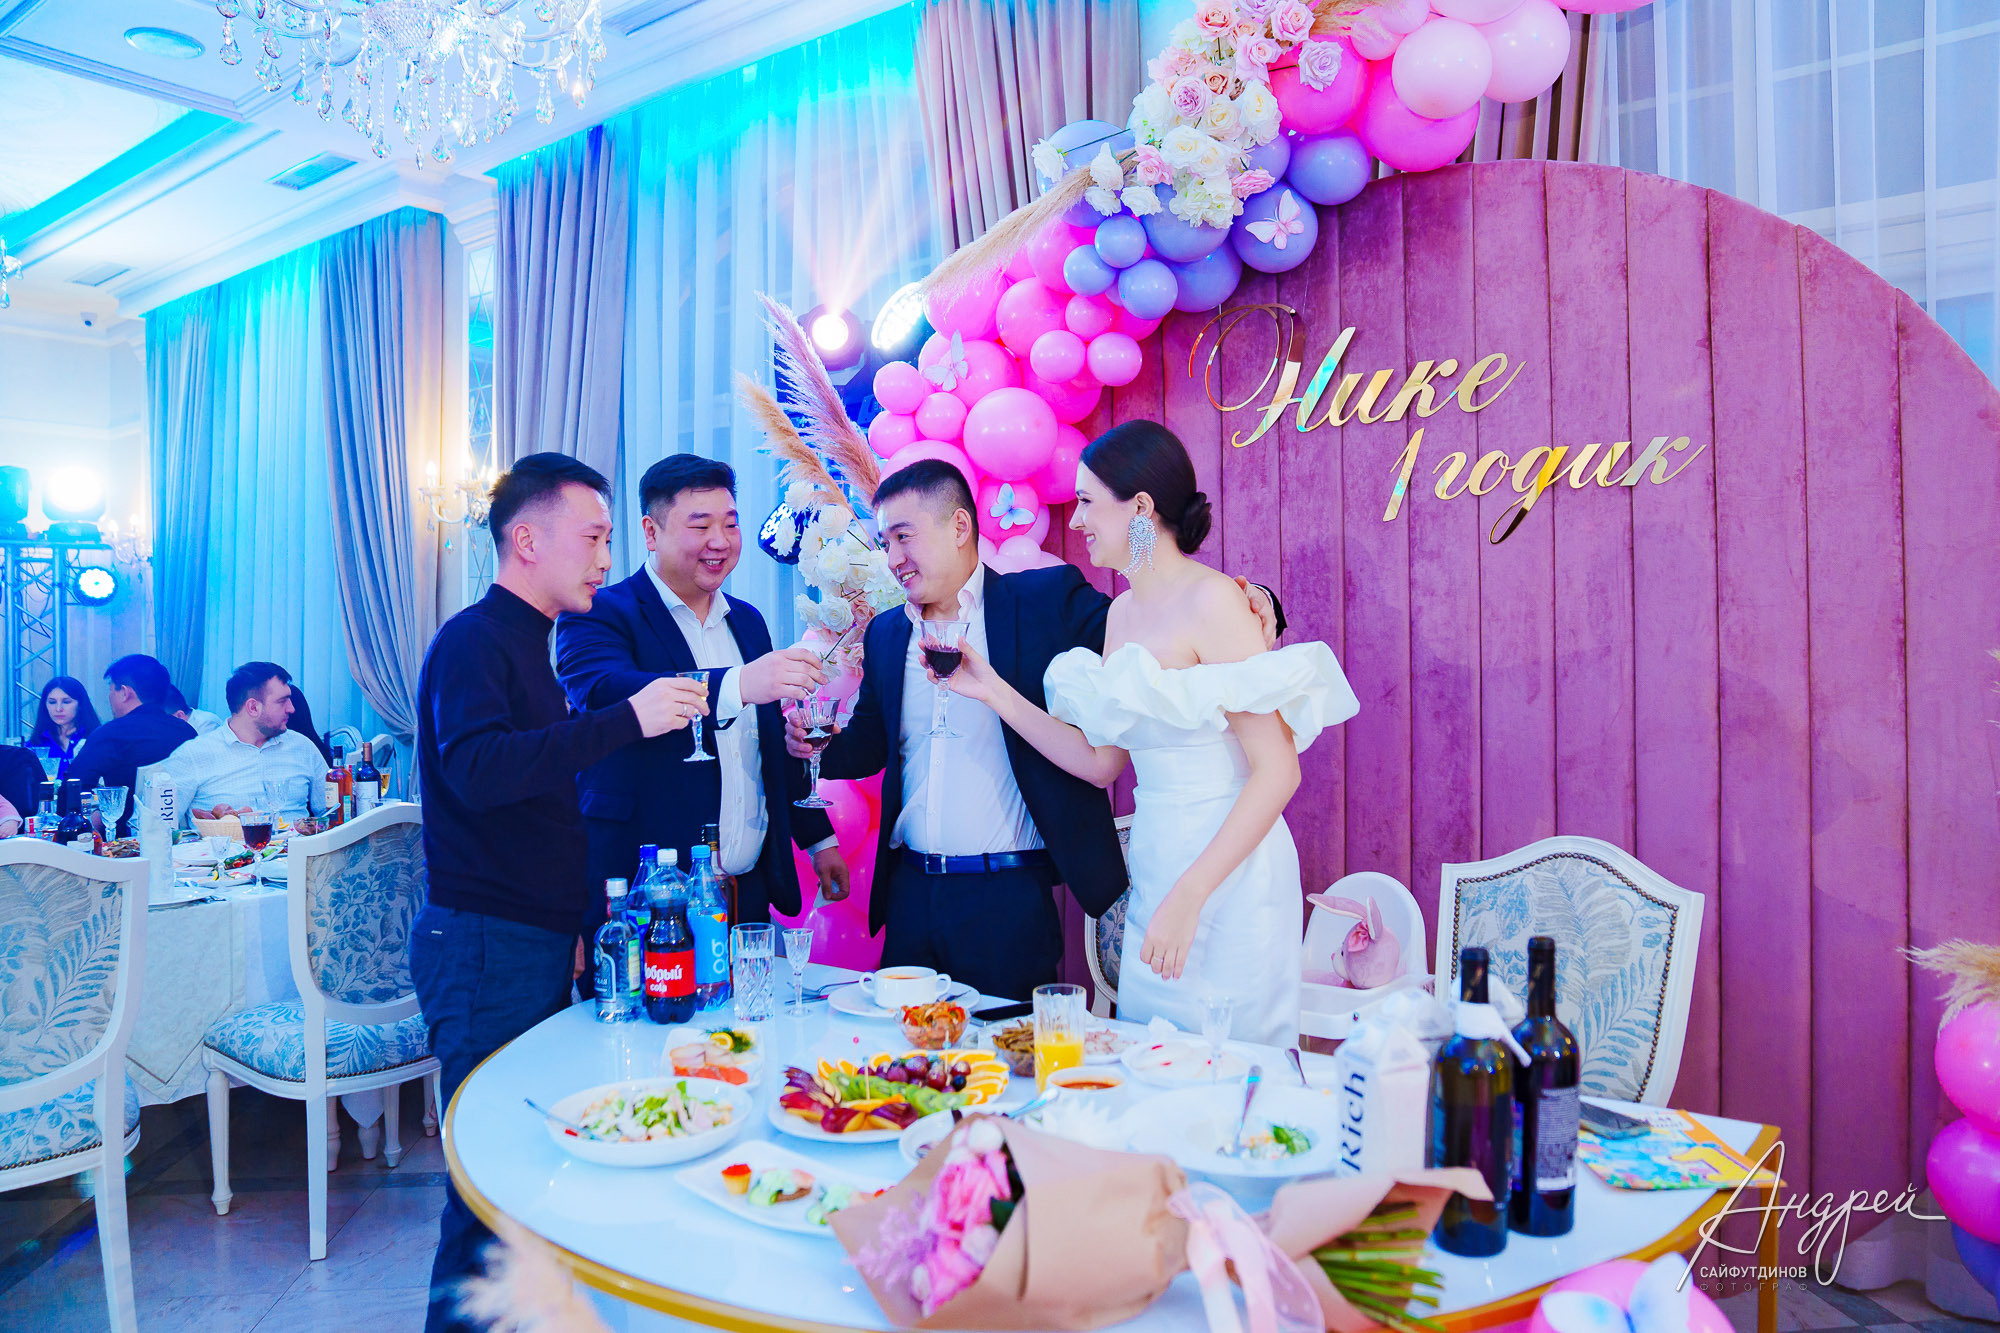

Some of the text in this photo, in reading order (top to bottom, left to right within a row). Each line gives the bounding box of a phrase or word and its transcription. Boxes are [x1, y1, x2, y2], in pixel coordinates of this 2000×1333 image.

[1188, 302, 1527, 448] Нике
[1382, 427, 1707, 544] 1 годик
[160, 788, 174, 821] Rich
[649, 984, 668, 993] cola
[1341, 1072, 1366, 1172] Rich
